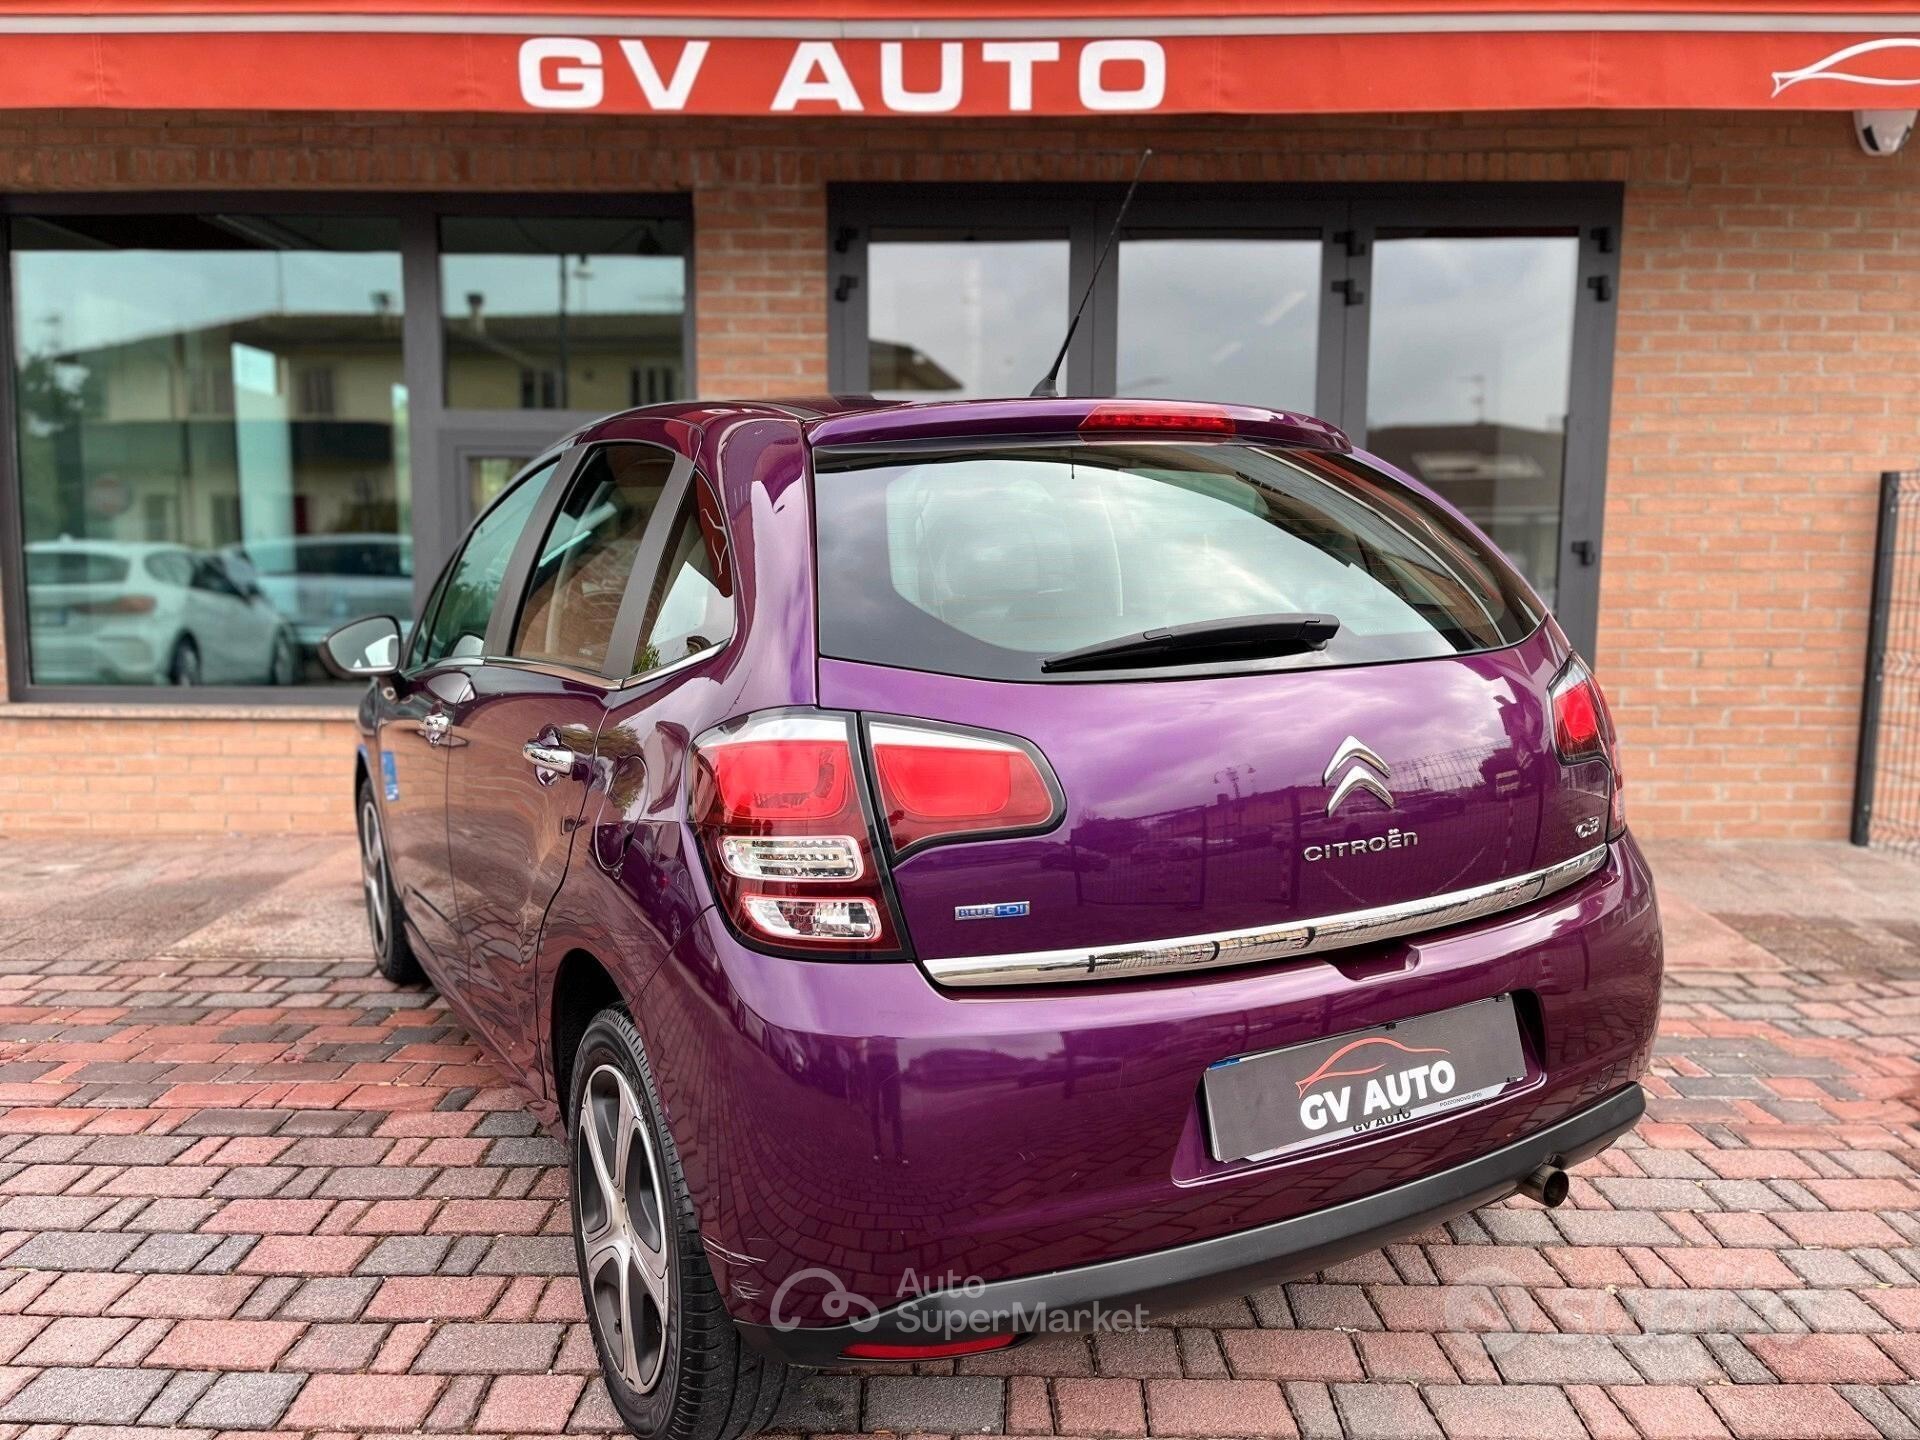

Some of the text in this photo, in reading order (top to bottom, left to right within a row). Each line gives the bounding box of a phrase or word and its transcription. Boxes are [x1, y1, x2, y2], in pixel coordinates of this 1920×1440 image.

[518, 37, 1166, 112] GV AUTO
[1575, 816, 1600, 838] C3
[1300, 1060, 1456, 1131] GV AUTO
[1352, 1111, 1412, 1133] GV AUTO
